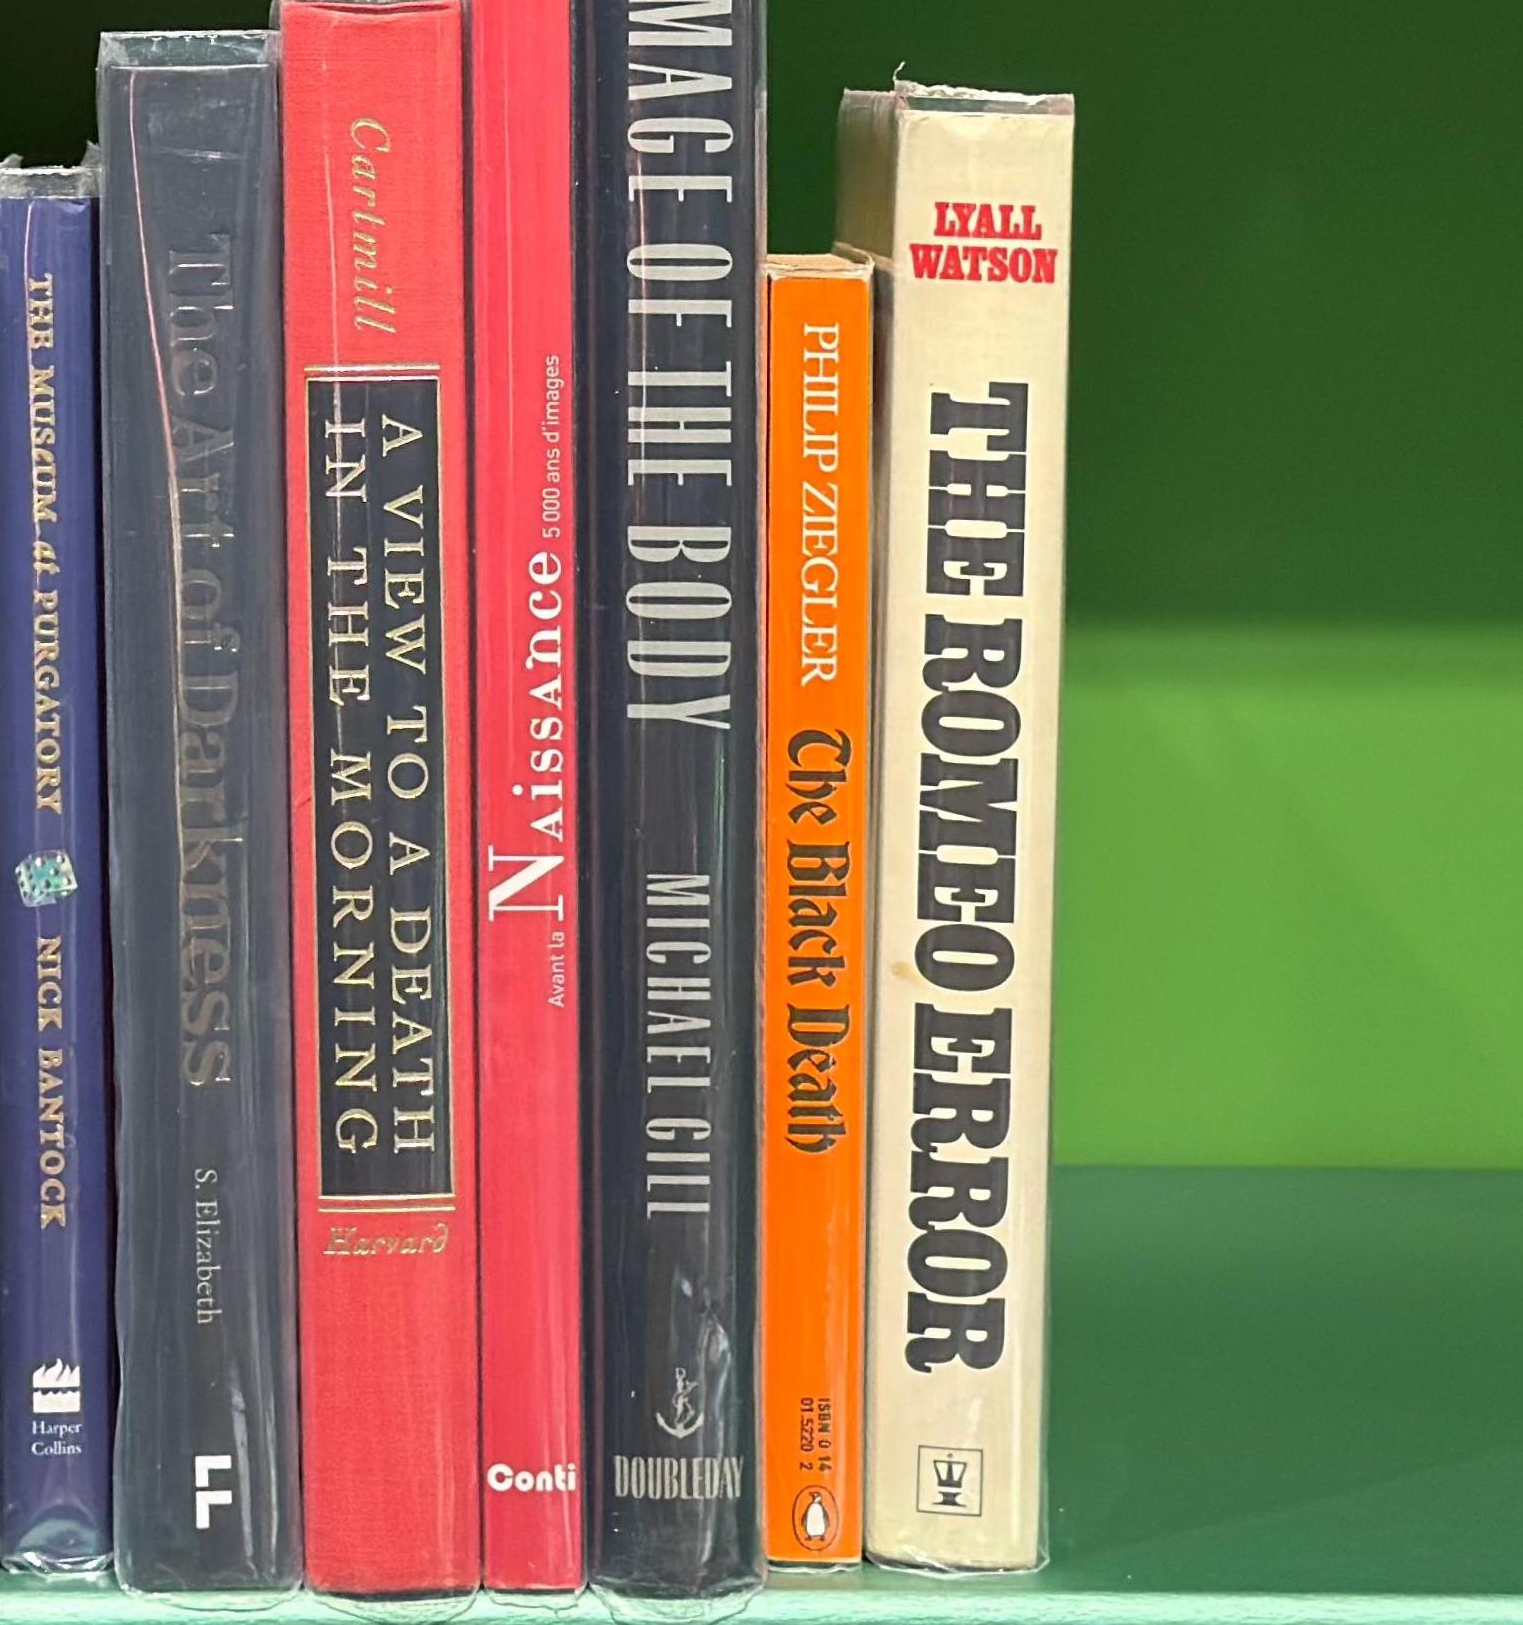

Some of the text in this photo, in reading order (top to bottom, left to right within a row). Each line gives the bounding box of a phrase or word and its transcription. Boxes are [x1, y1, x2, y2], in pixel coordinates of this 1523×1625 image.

[349, 117, 397, 334] Cartmill
[909, 243, 1058, 285] WATSON
[934, 201, 1042, 241] LYALL
[28, 272, 54, 350] THE
[627, 243, 733, 328] OF
[542, 354, 565, 443] d'images
[627, 361, 732, 486] THE
[542, 448, 561, 483] ans
[800, 323, 839, 688] PHILIP ZIEGLER
[32, 540, 60, 574] at
[168, 233, 244, 1087] The Art of Darkness
[626, 526, 732, 730] BODY
[32, 590, 63, 815] PURGATORY
[324, 418, 378, 1155] IN THE MORNING
[382, 413, 435, 1153] A VIEW TO A DEATH
[905, 381, 1029, 1374] THE ROMEO ERROR
[548, 955, 565, 1008] Avant
[549, 931, 565, 952] la
[785, 728, 852, 1154] The Black Death
[37, 936, 68, 1230] NICK BANTOCK
[646, 874, 711, 1220] MICHAEL GILL
[194, 1168, 223, 1325] S. Elizabeth
[323, 1222, 450, 1256] Harvard
[31, 1420, 83, 1439] Harper
[31, 1439, 83, 1456] Collins
[818, 1398, 831, 1432] ISBN
[487, 1463, 576, 1492] Conti
[613, 1455, 744, 1499] DOUBLEDAY
